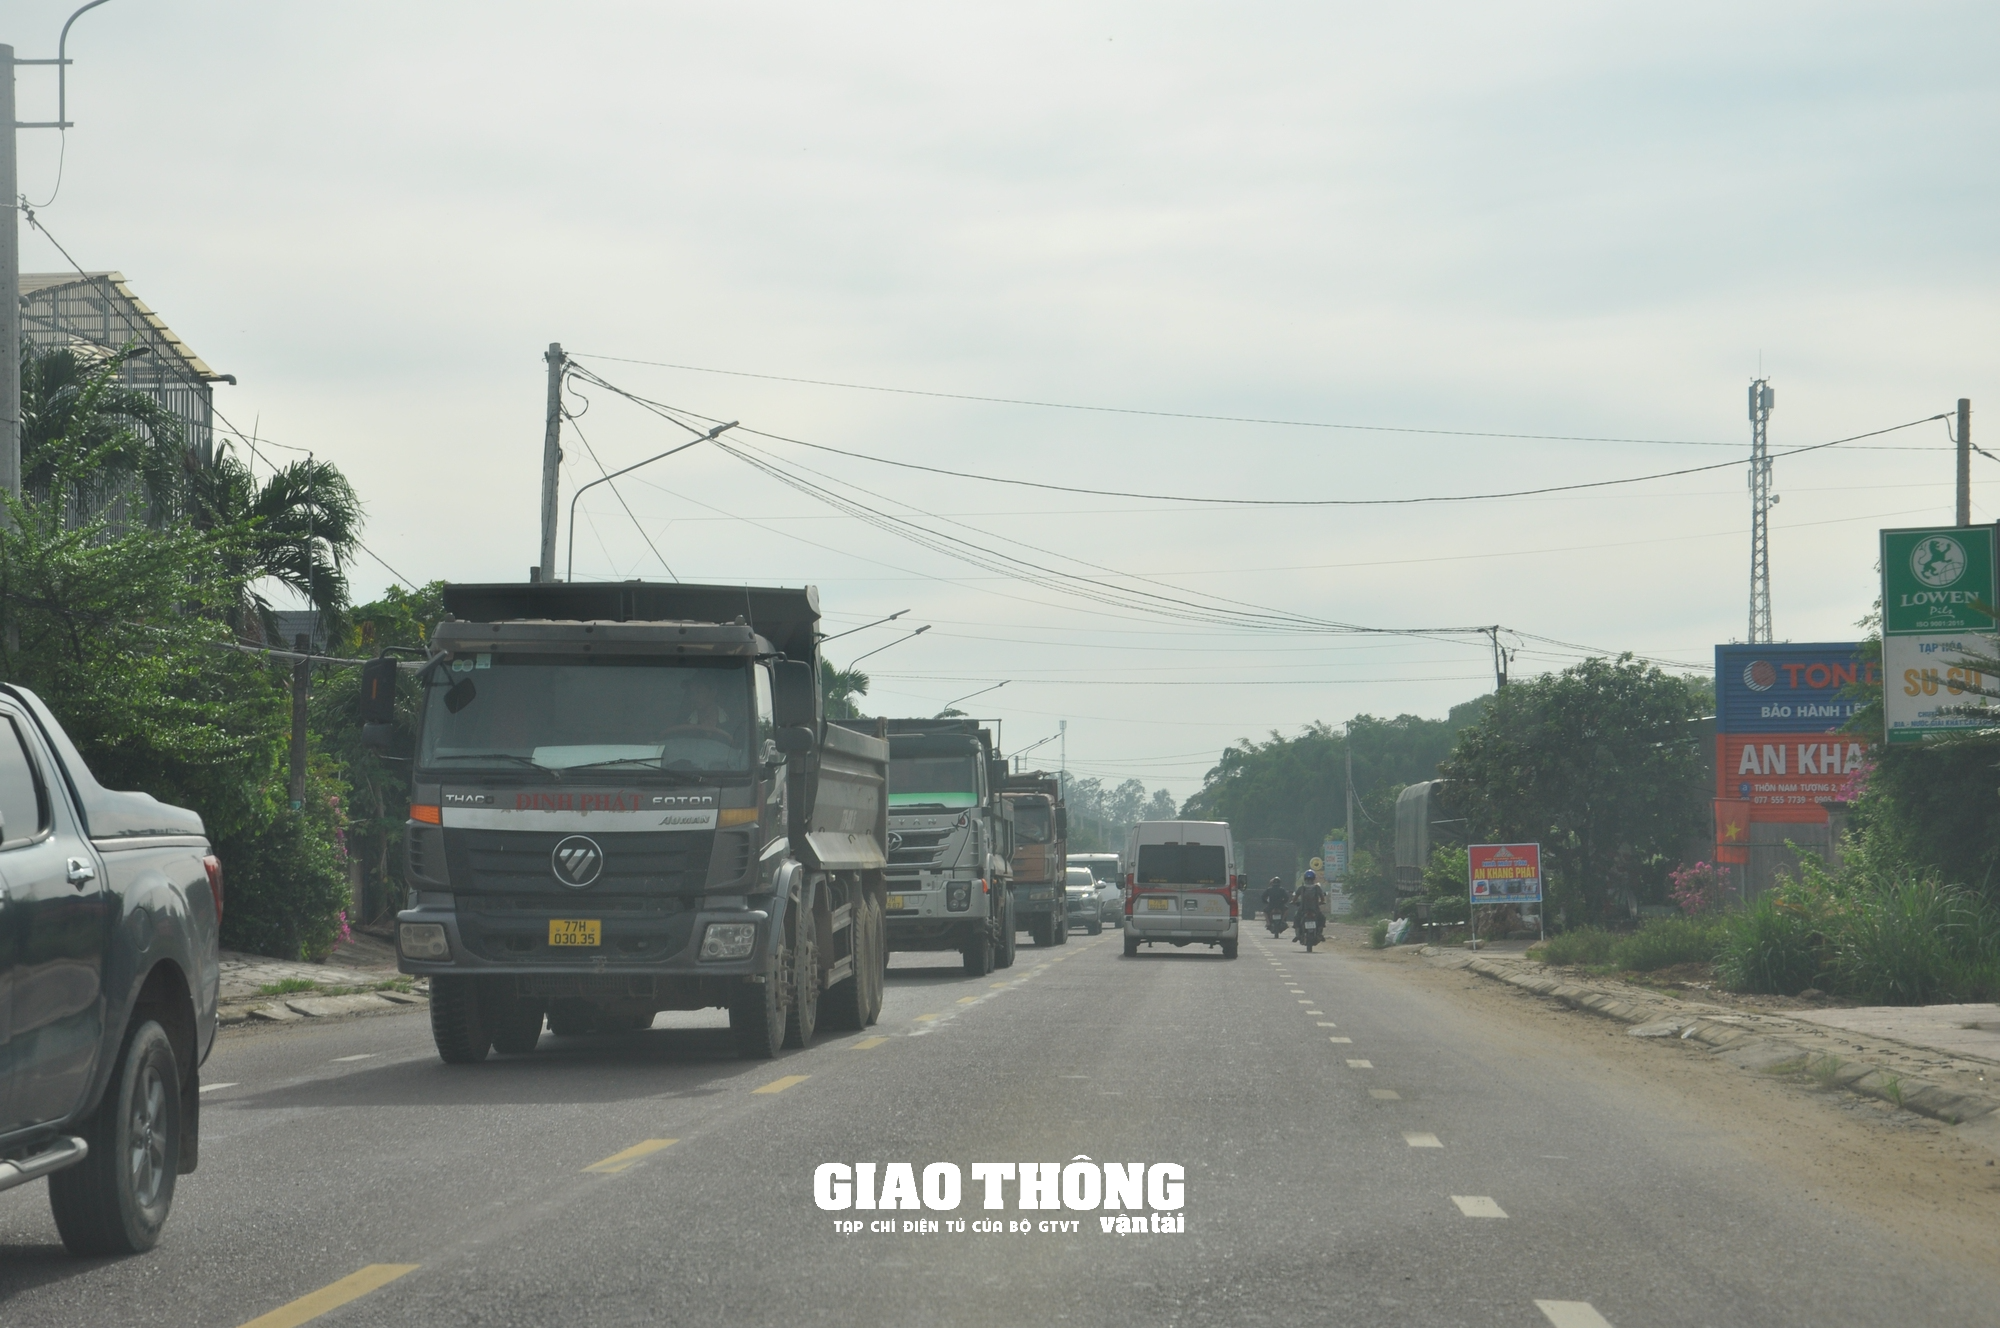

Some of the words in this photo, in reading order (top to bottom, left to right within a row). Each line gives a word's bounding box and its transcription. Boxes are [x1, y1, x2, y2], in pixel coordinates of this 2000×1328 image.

[1930, 605, 1953, 615] Pils
[1919, 643, 1938, 654] TẠP
[1782, 663, 1857, 689] TON
[1761, 703, 1791, 717] BẢO
[1797, 703, 1840, 717] HÀNH
[1738, 744, 1786, 775] AN
[1754, 782, 1776, 792] THÔN
[1800, 783, 1829, 793] TƯỢNG
[580, 790, 643, 811] PHÁT
[1475, 868, 1485, 879] AN
[1487, 867, 1513, 879] KHANG
[1516, 865, 1535, 878] PHÁT
[564, 921, 586, 932] 77H
[554, 933, 595, 945] 030.35
